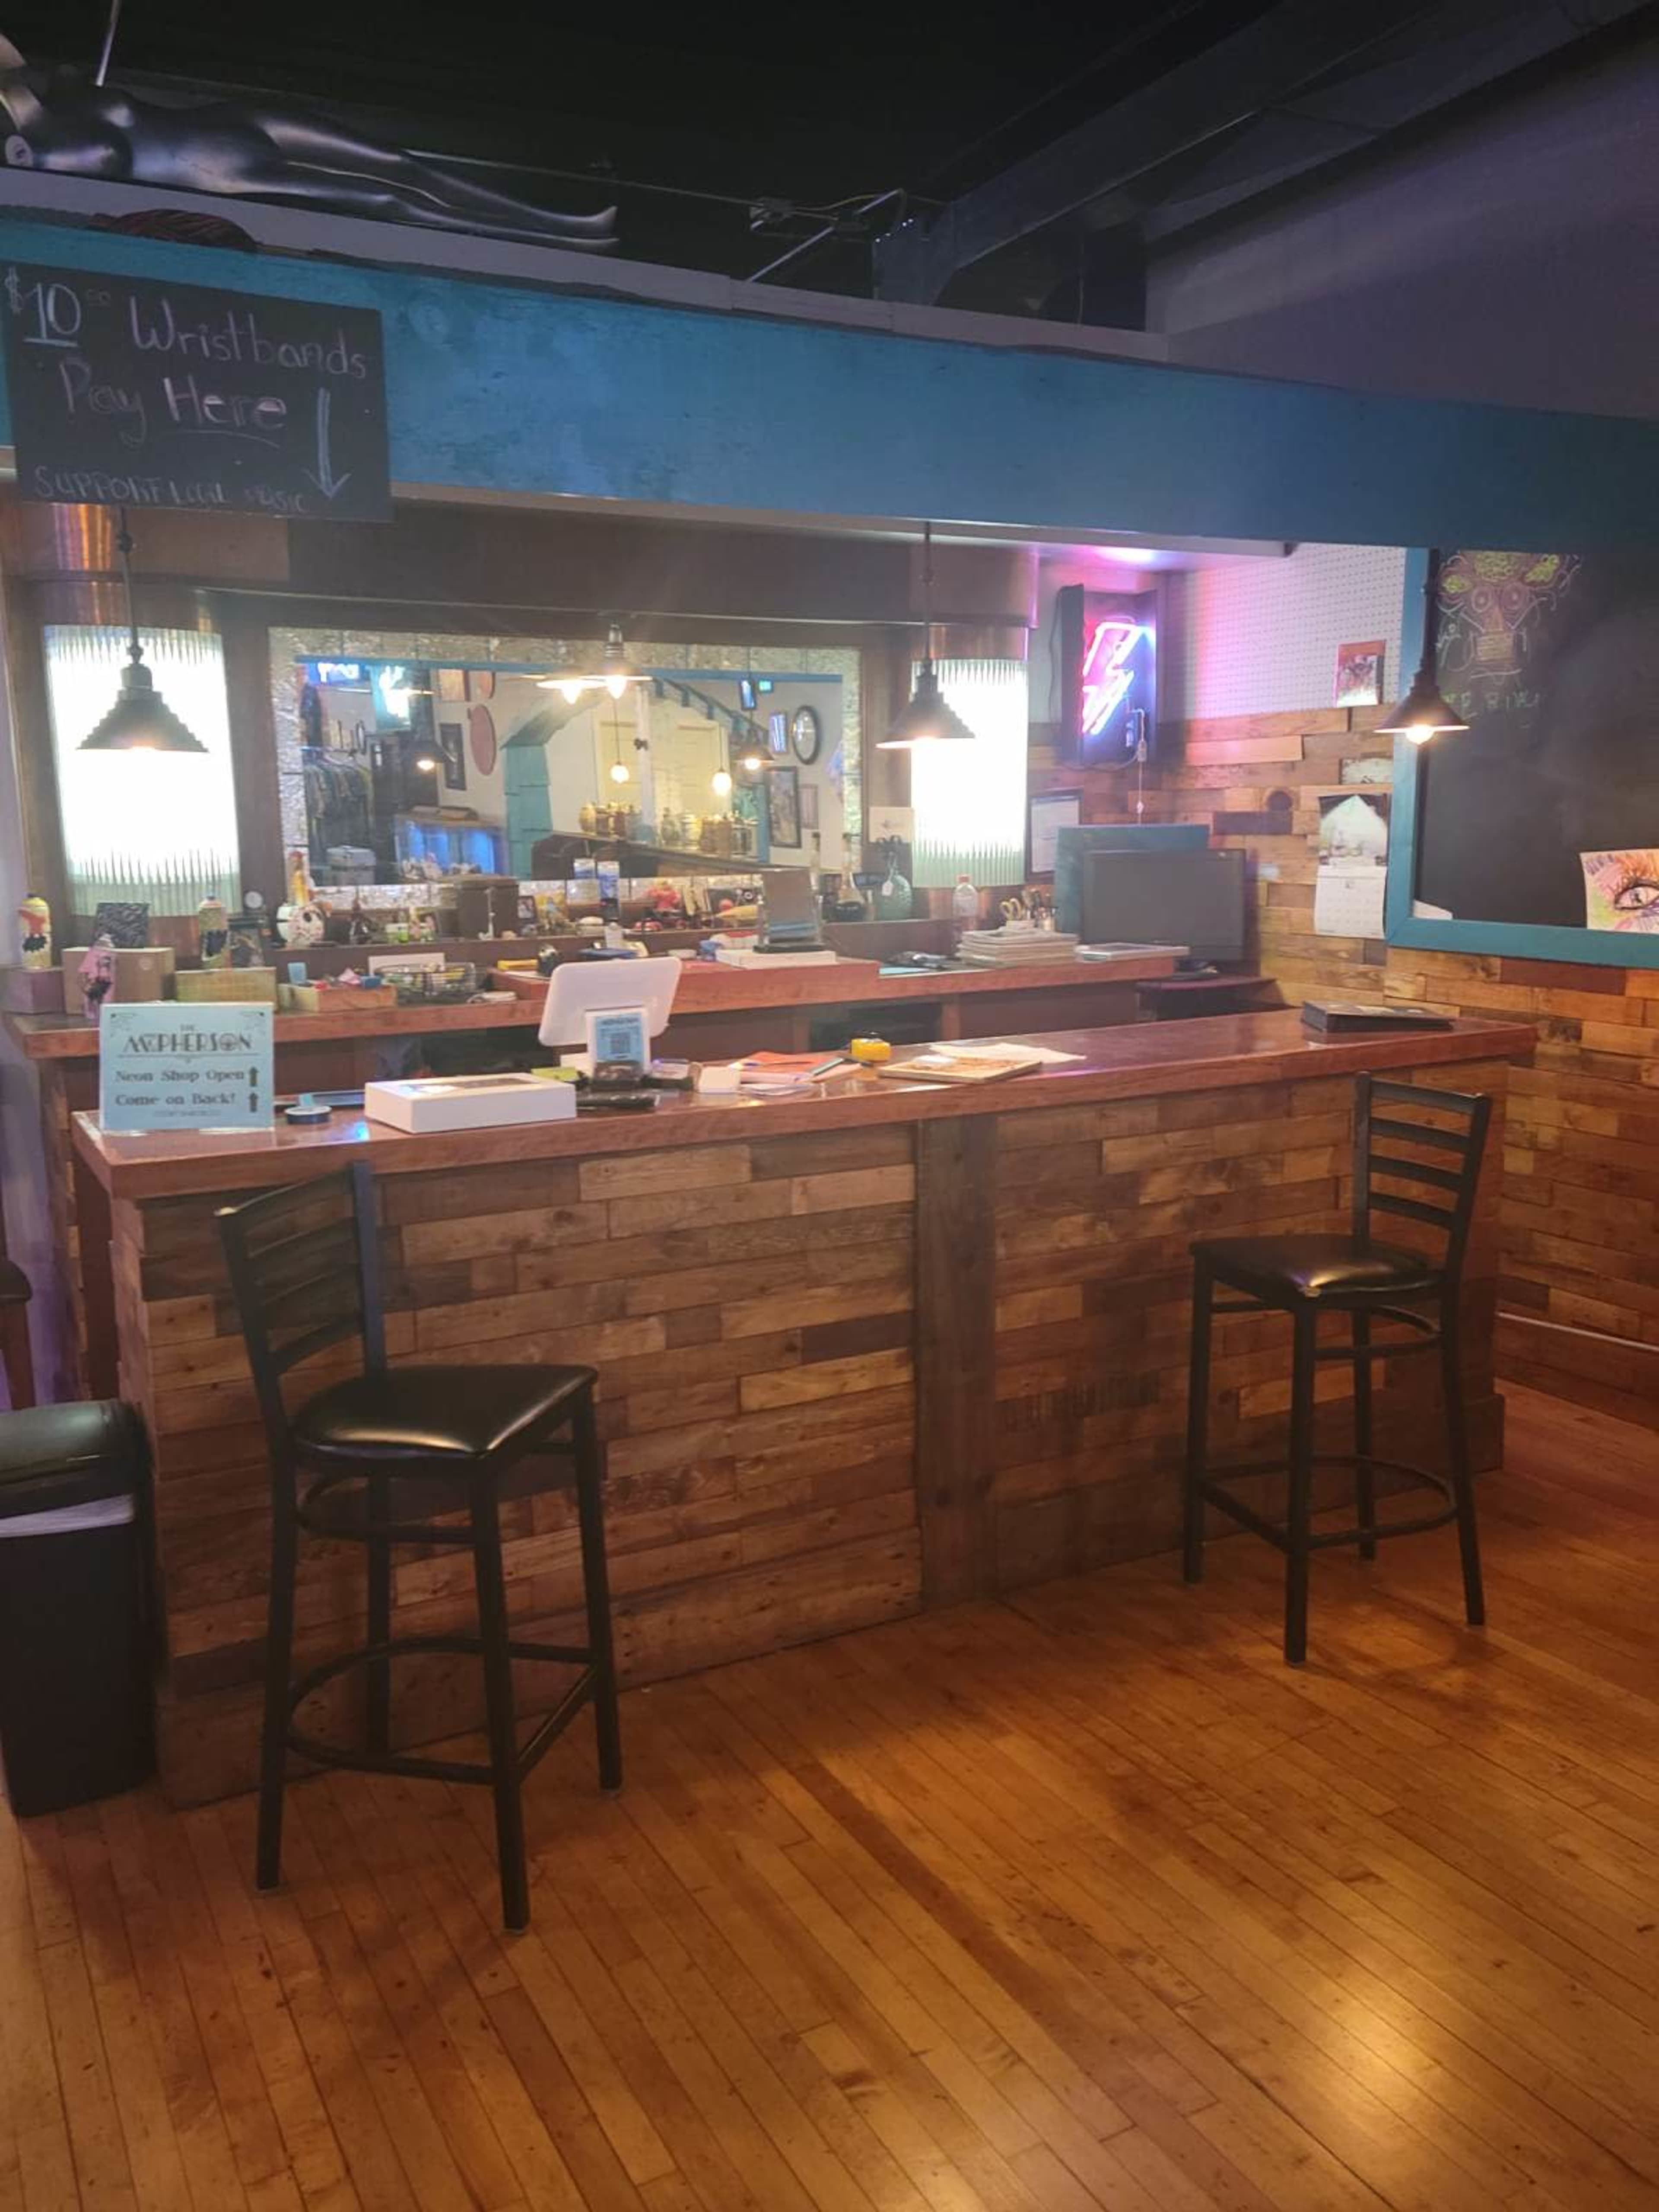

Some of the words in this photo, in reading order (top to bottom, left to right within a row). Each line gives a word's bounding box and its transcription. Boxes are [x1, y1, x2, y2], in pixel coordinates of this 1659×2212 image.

[130, 295, 367, 379] Wristbands
[59, 356, 147, 449] Pay
[162, 372, 288, 431] Here
[115, 1071, 154, 1082] Neon
[161, 1069, 200, 1084] Shop
[206, 1069, 245, 1083] Open
[116, 1094, 159, 1106] Come
[192, 1092, 236, 1105] Back!
